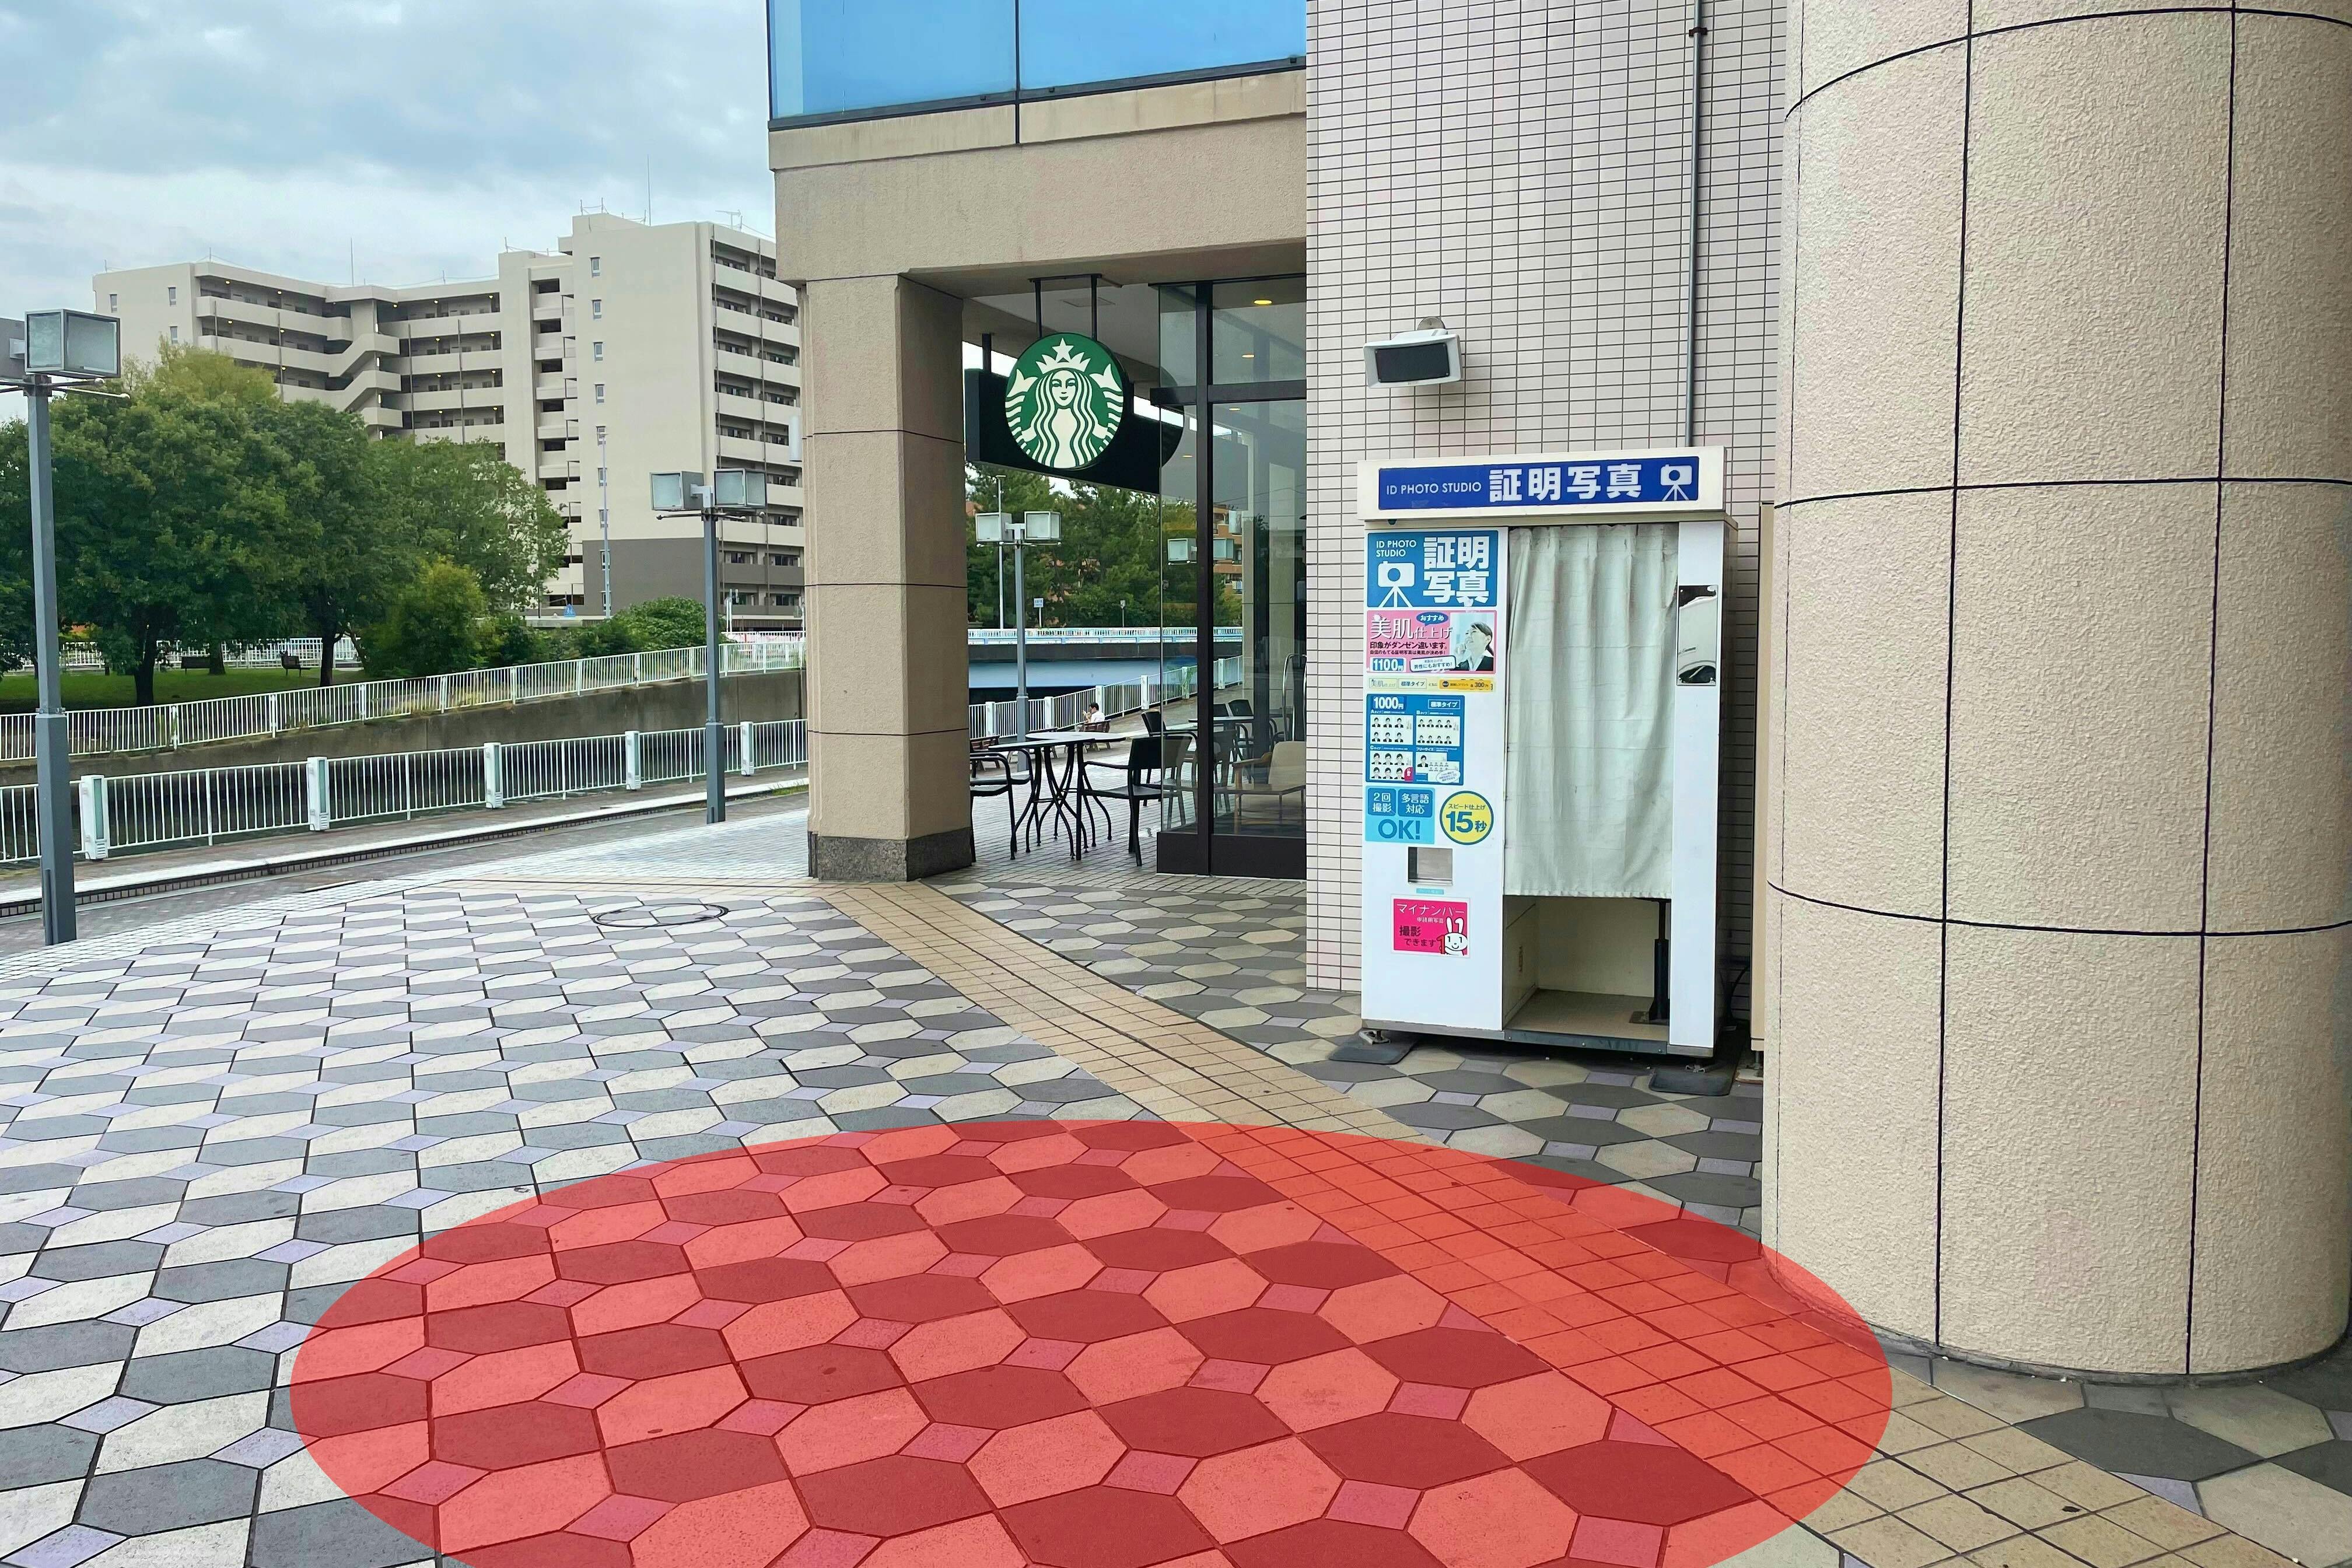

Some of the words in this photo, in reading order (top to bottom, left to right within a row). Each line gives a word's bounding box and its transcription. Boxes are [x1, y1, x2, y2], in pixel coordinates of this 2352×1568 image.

[1387, 485, 1397, 495] ID
[1401, 484, 1438, 494] PHOTO
[1442, 481, 1482, 493] STUDIO
[1489, 463, 1642, 502] 証明写真
[1387, 540, 1417, 548] PHOTO
[1376, 549, 1406, 557] STUDIO
[1423, 536, 1490, 569] 証明
[1423, 569, 1489, 604] 写真
[1371, 616, 1453, 639] 美肌仕上げ
[1373, 696, 1404, 709] 1000円
[1373, 793, 1391, 802] 2回
[1401, 793, 1429, 804] 多言語
[1373, 802, 1392, 813] 撮影
[1405, 804, 1424, 814] 対応
[1446, 811, 1487, 832] 15秒
[1378, 819, 1420, 840] OK!
[1396, 904, 1465, 916] マイナンバー
[1399, 925, 1421, 936] 撮影
[1404, 938, 1437, 947] できます
